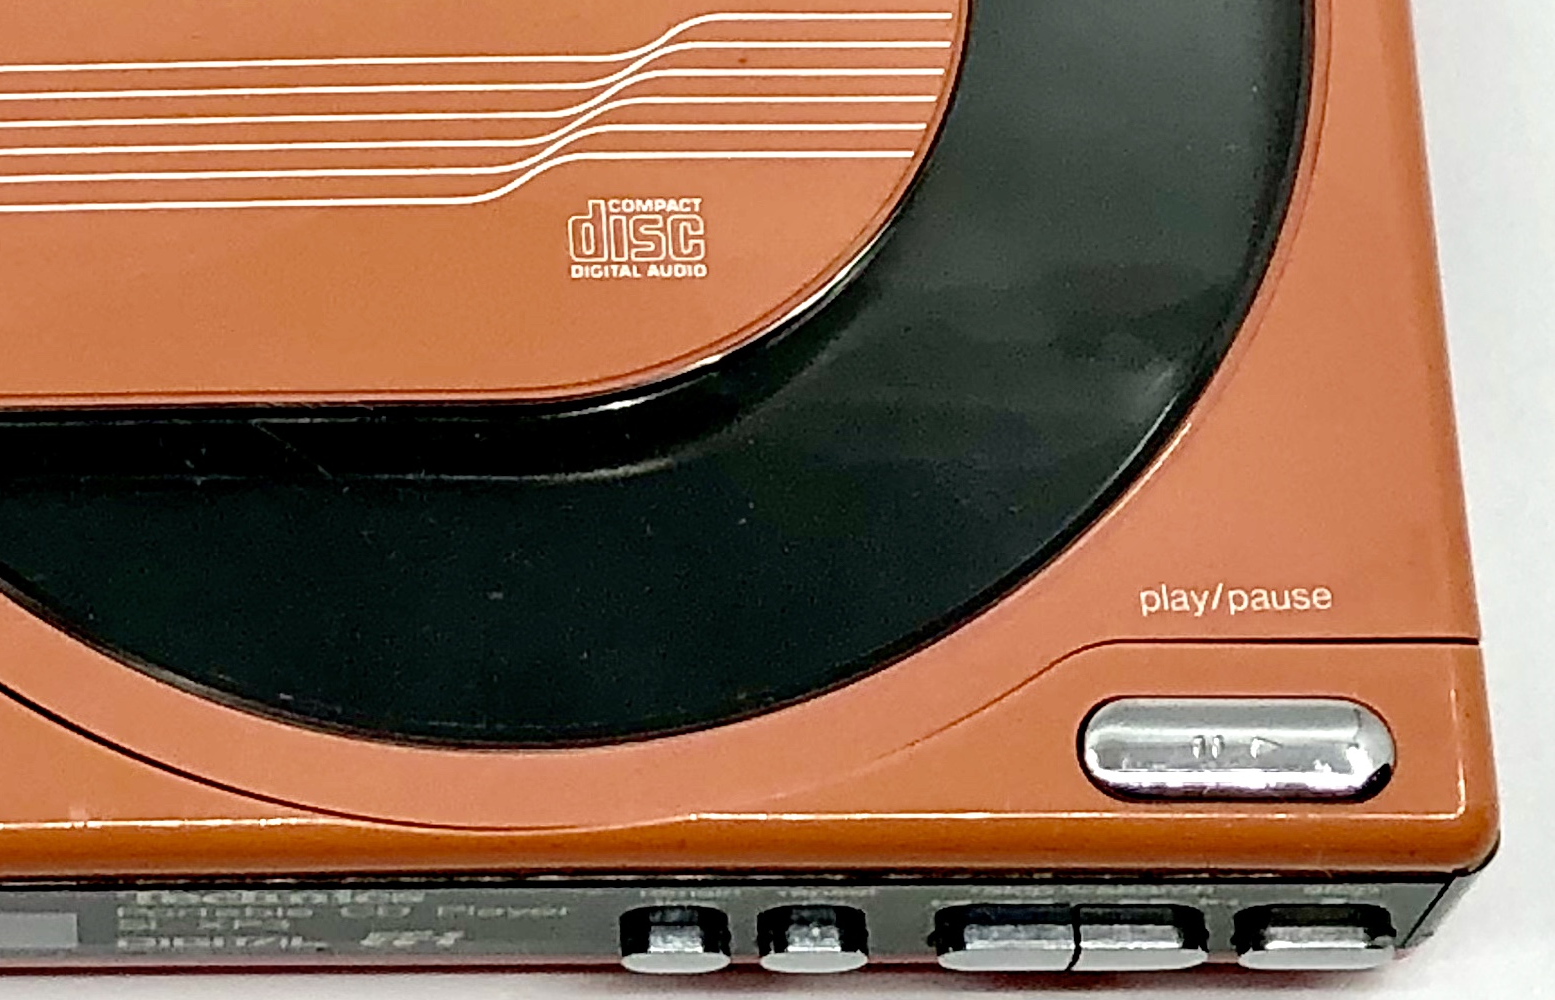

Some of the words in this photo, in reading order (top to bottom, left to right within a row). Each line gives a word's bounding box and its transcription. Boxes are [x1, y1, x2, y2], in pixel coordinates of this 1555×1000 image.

[607, 197, 702, 213] COMPACT
[570, 264, 642, 279] DIGITAL
[646, 263, 708, 278] AUDIO
[1139, 582, 1332, 618] play/pause
